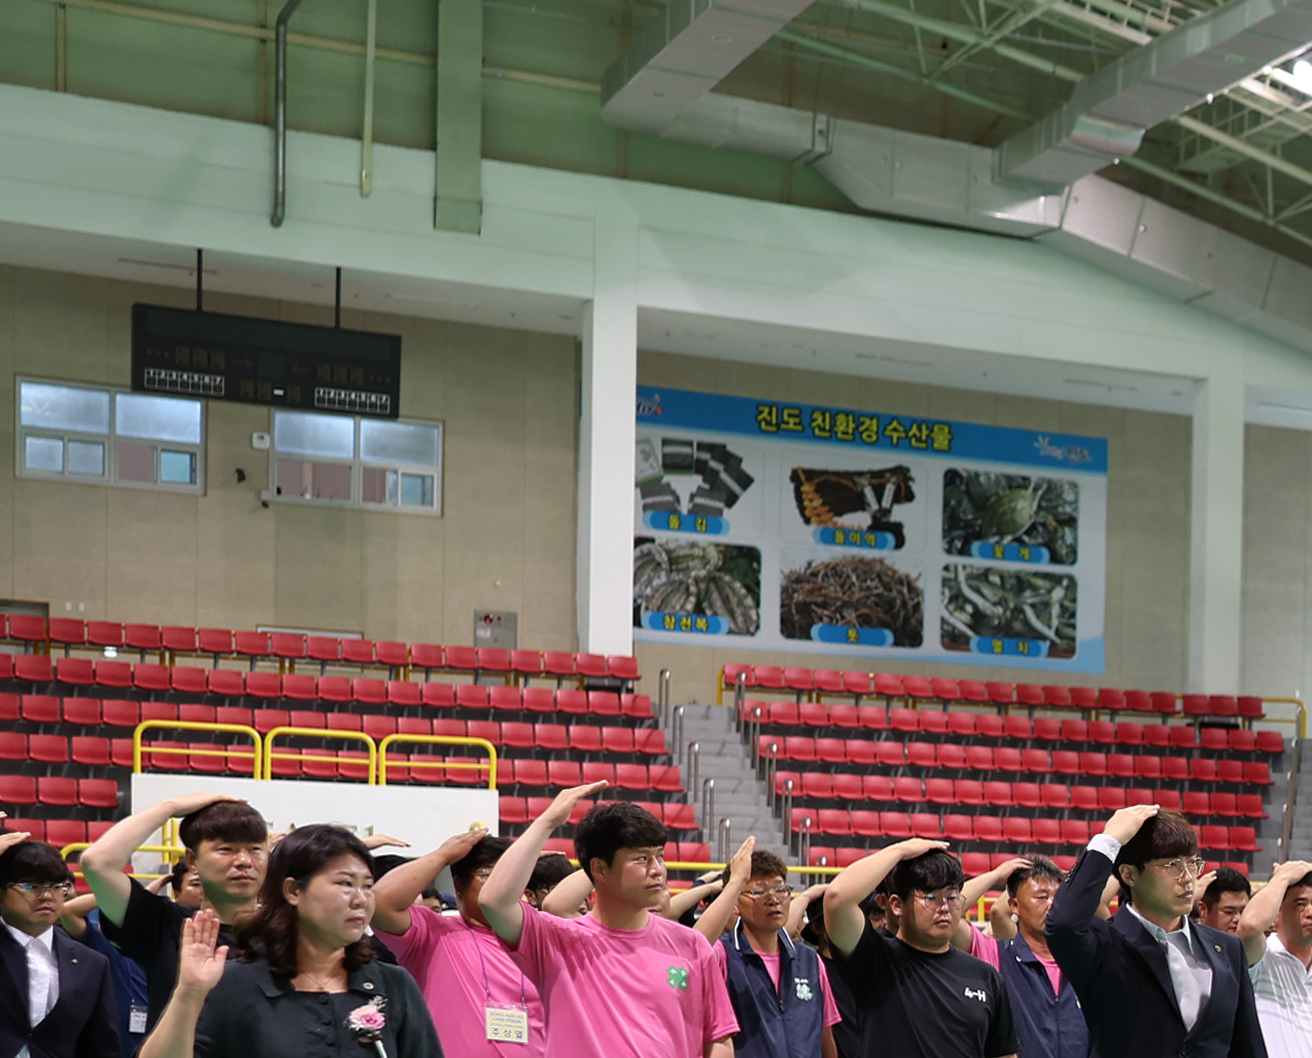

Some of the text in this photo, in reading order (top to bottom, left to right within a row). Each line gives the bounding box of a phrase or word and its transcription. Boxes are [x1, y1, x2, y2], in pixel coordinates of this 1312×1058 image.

[756, 404, 953, 451] 진도 친환경 수산물
[964, 987, 986, 1002] 4-H
